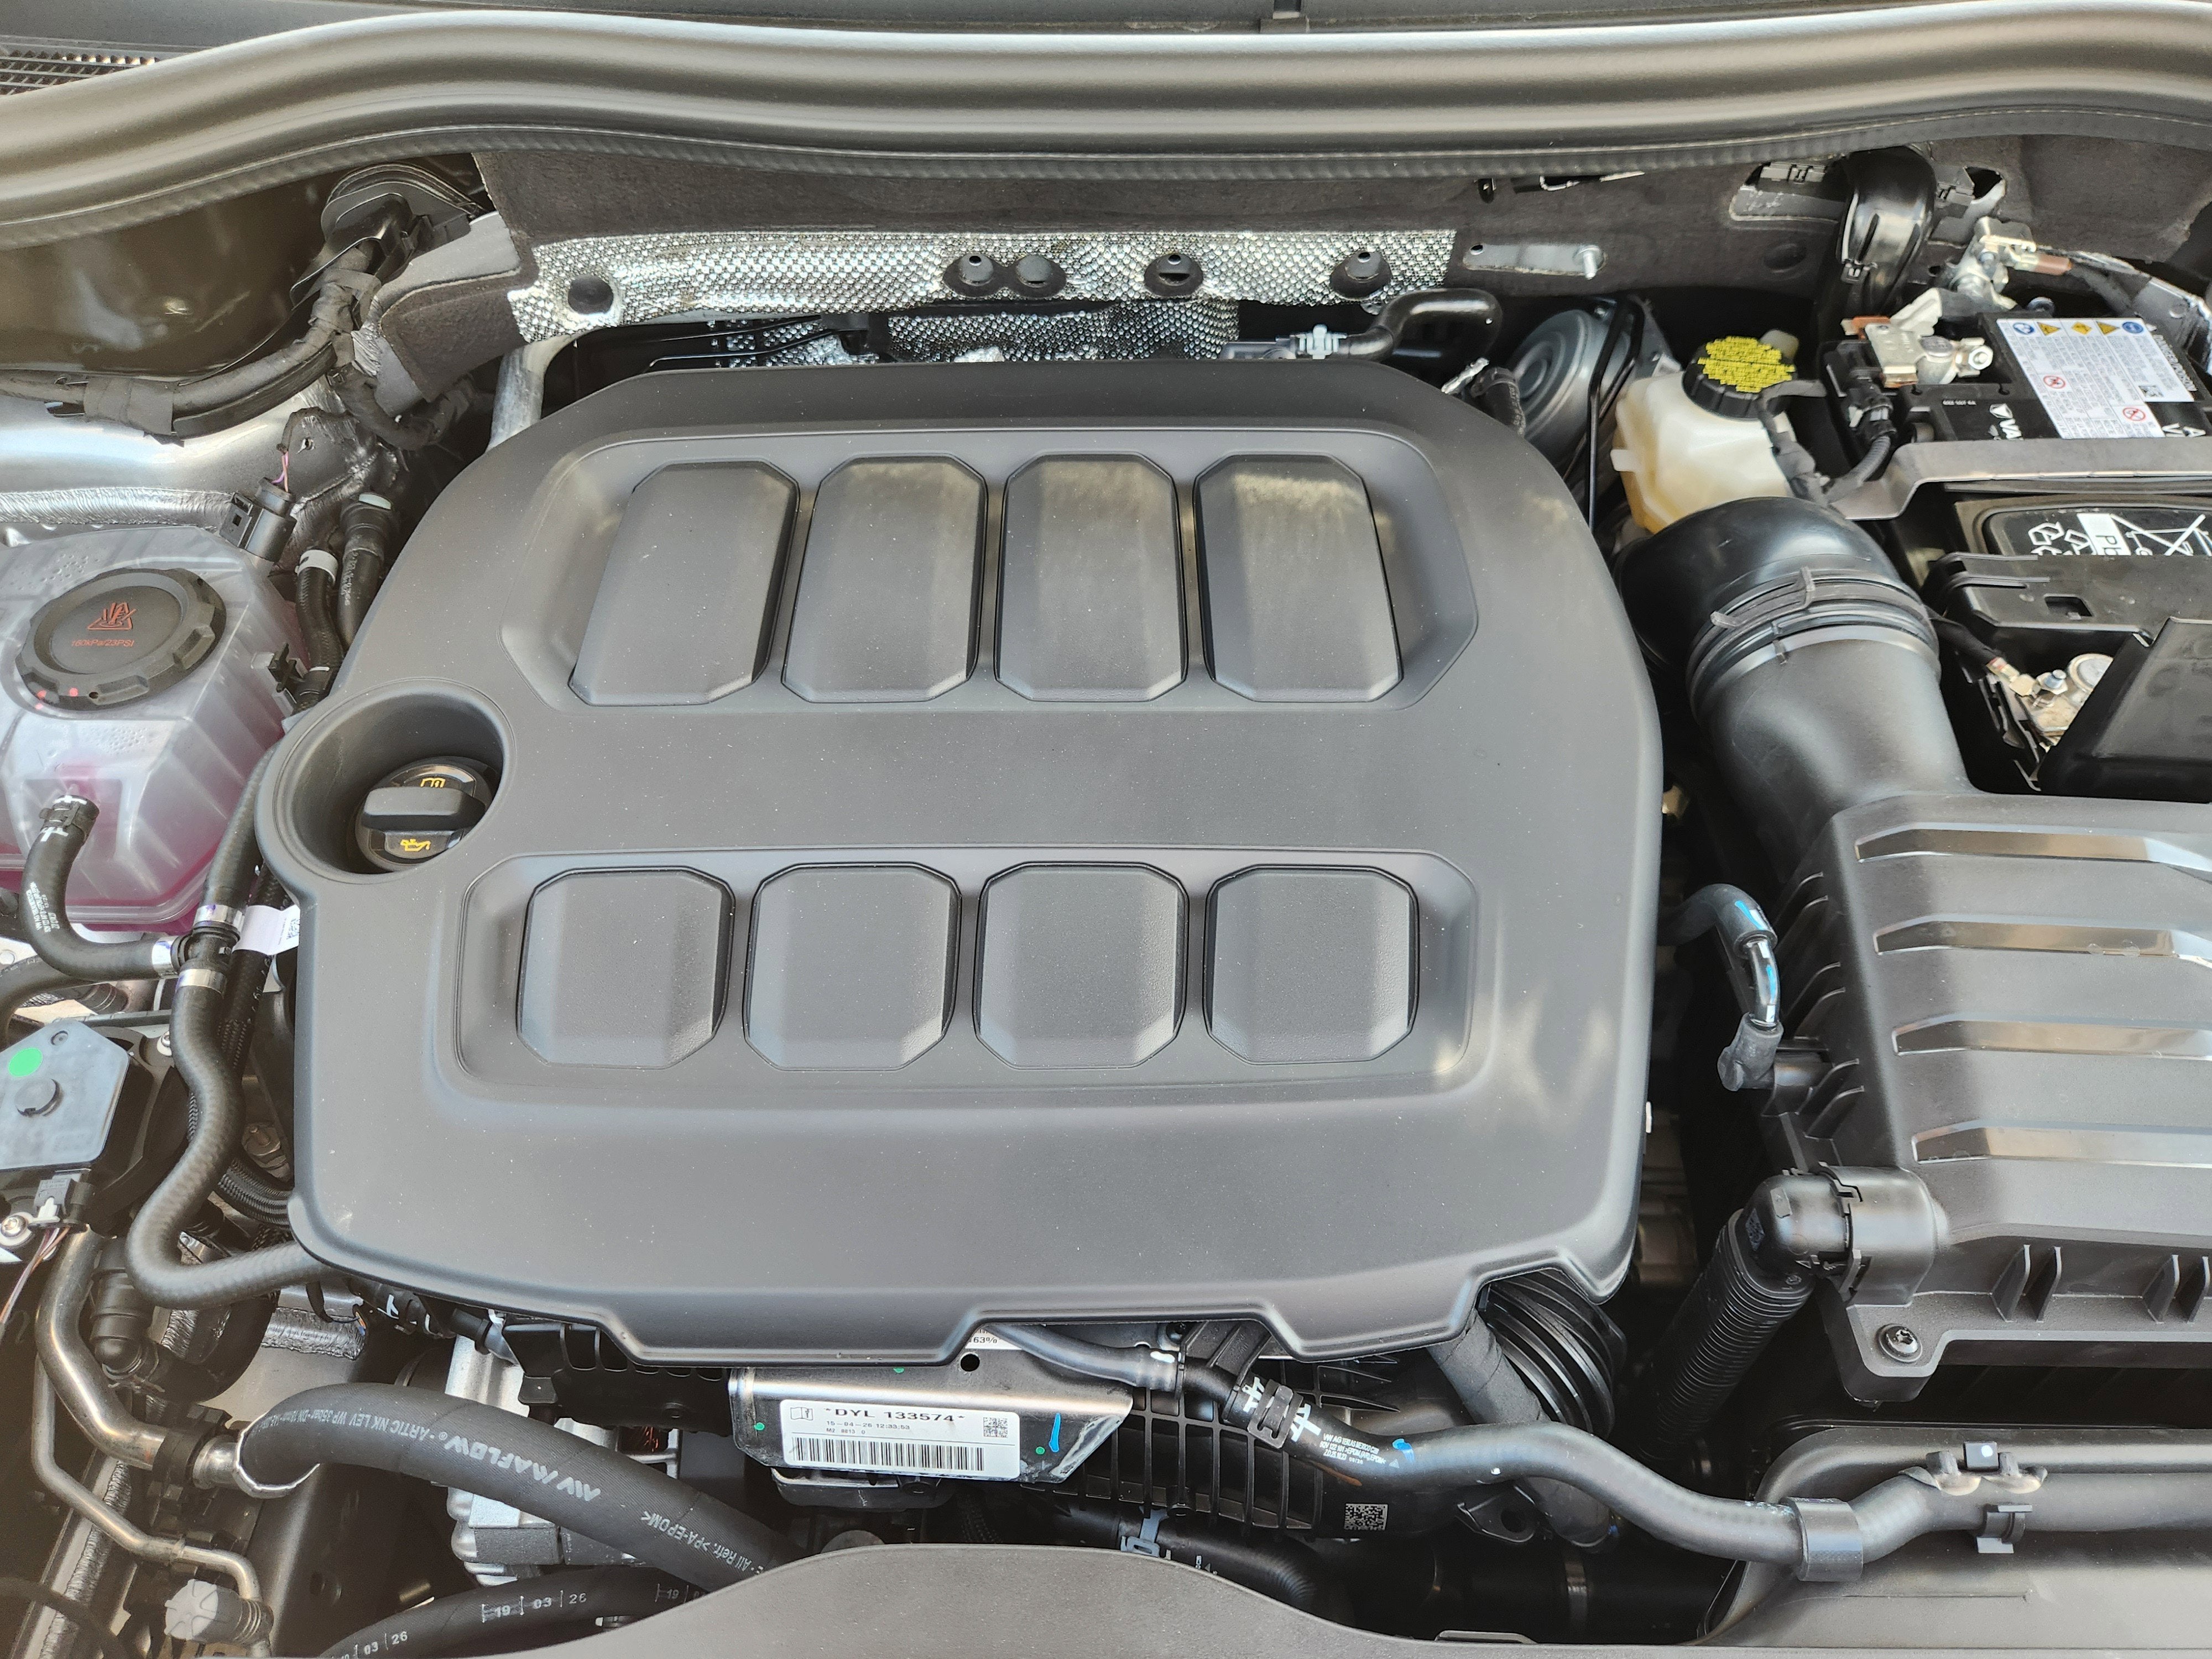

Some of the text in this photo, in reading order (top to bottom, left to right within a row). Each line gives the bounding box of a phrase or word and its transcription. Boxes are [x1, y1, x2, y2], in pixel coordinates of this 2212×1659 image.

[332, 1410, 348, 1426] WP
[348, 1412, 371, 1427] LEV
[371, 1415, 390, 1432] NK
[389, 1419, 430, 1441] ARTIC
[713, 1543, 738, 1565] Refr.
[734, 1556, 753, 1572] All
[666, 1589, 680, 1599] 19
[494, 1605, 510, 1618] 19
[364, 1631, 408, 1655] 03 26
